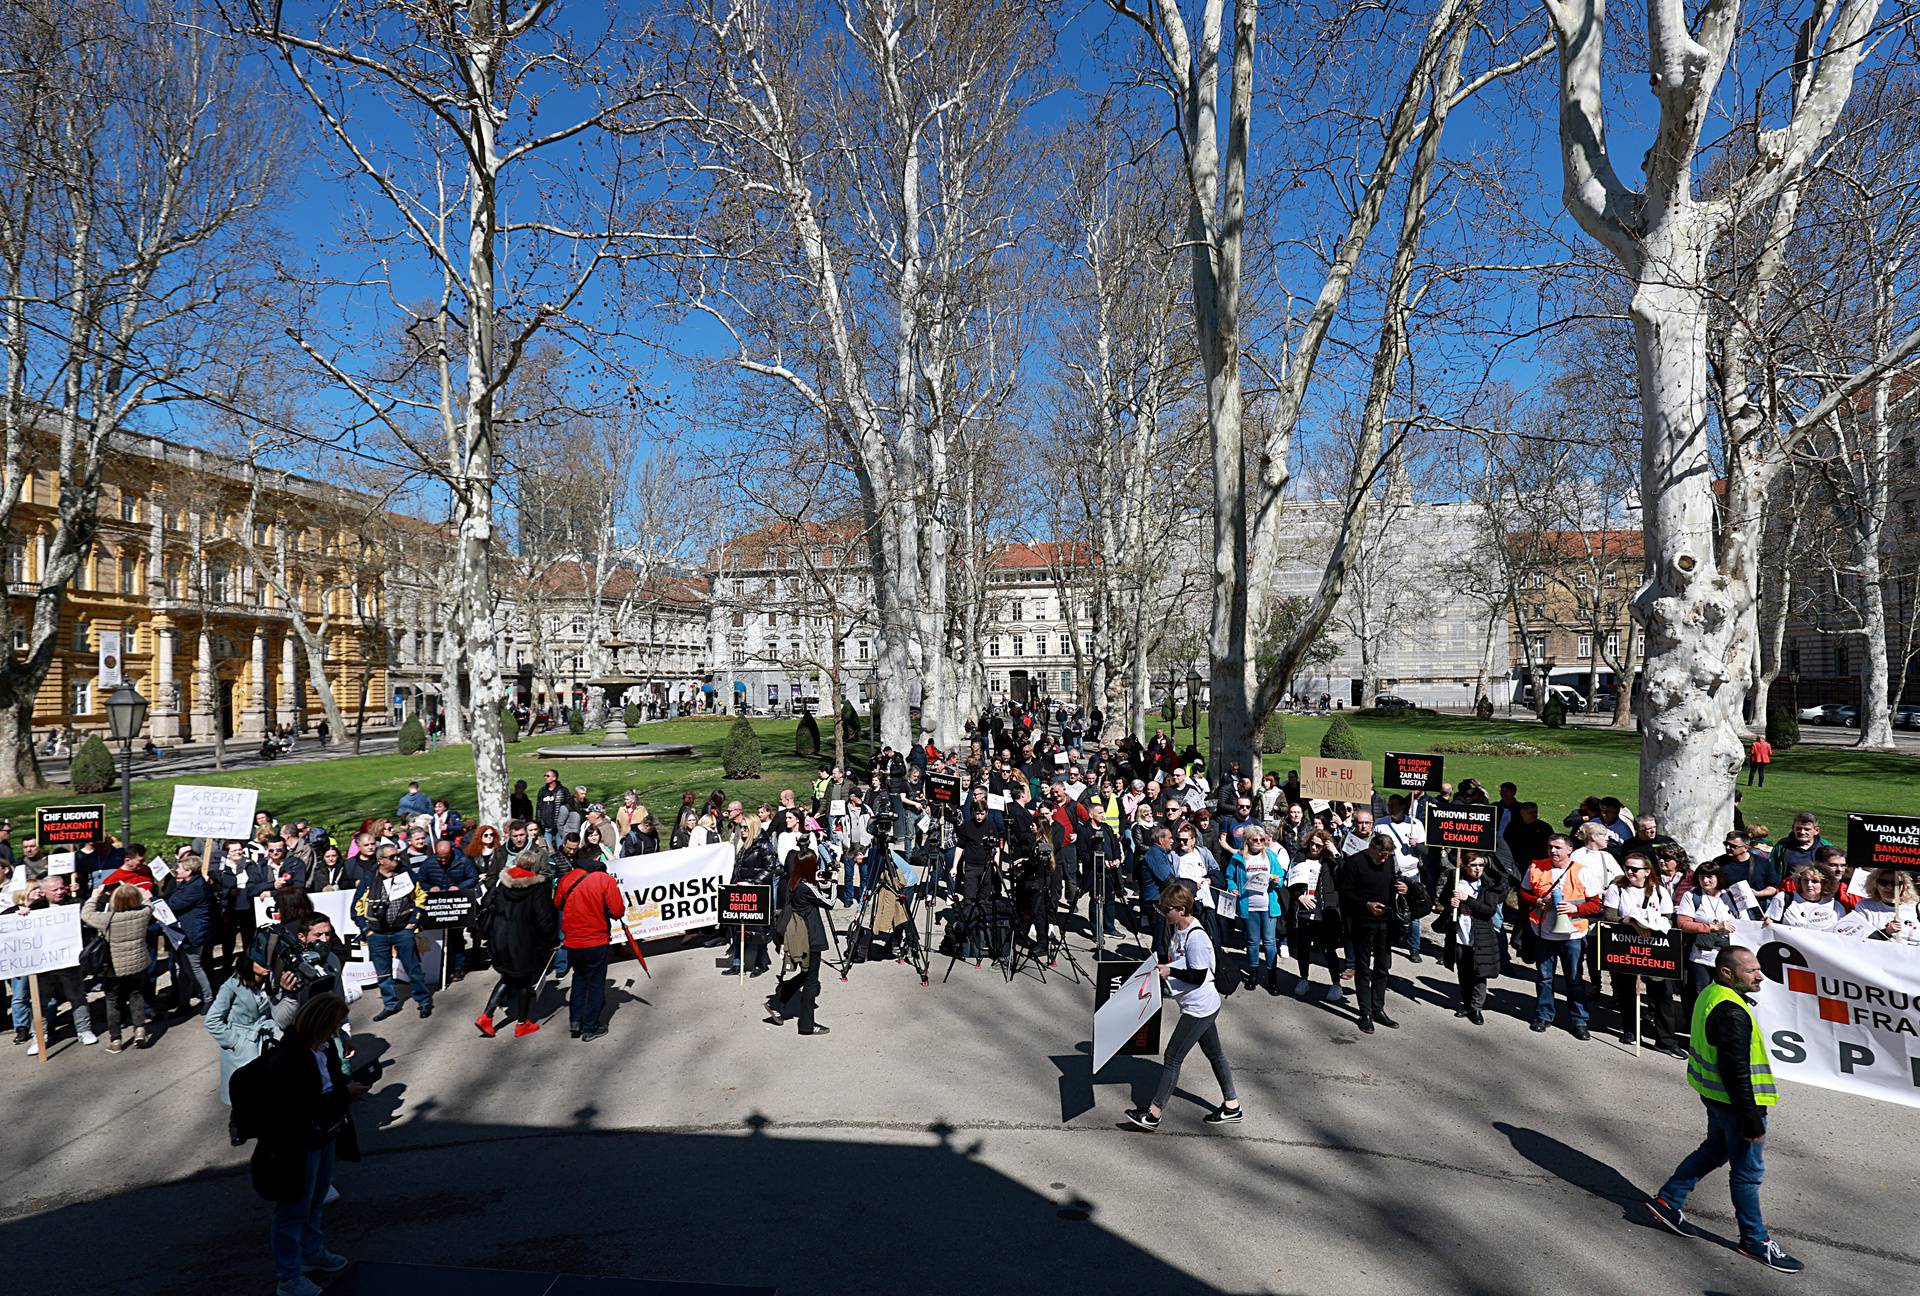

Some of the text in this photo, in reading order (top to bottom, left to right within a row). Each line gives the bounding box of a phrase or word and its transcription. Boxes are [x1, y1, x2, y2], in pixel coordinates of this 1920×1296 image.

[1316, 767, 1328, 778] HR
[1340, 769, 1353, 779] EU
[43, 811, 99, 821] CHF UGOVOR
[1433, 810, 1490, 822] VRHOVNI SUDE
[44, 822, 93, 831] NEZAKONIT
[1440, 820, 1483, 832] JOŠ UVIJEK
[1864, 824, 1896, 834] VLADA
[50, 831, 92, 840] NIŠTETAN
[1443, 832, 1478, 843] ČEKAMO!
[1880, 834, 1920, 845] POMAŽE
[730, 893, 757, 902] 55.000
[722, 910, 764, 920] ČEKA PRAVDU
[1612, 932, 1670, 947] KONVERZIJA
[1630, 946, 1652, 956] NIJE
[1606, 954, 1676, 970] OBEŠTEĆENJE!
